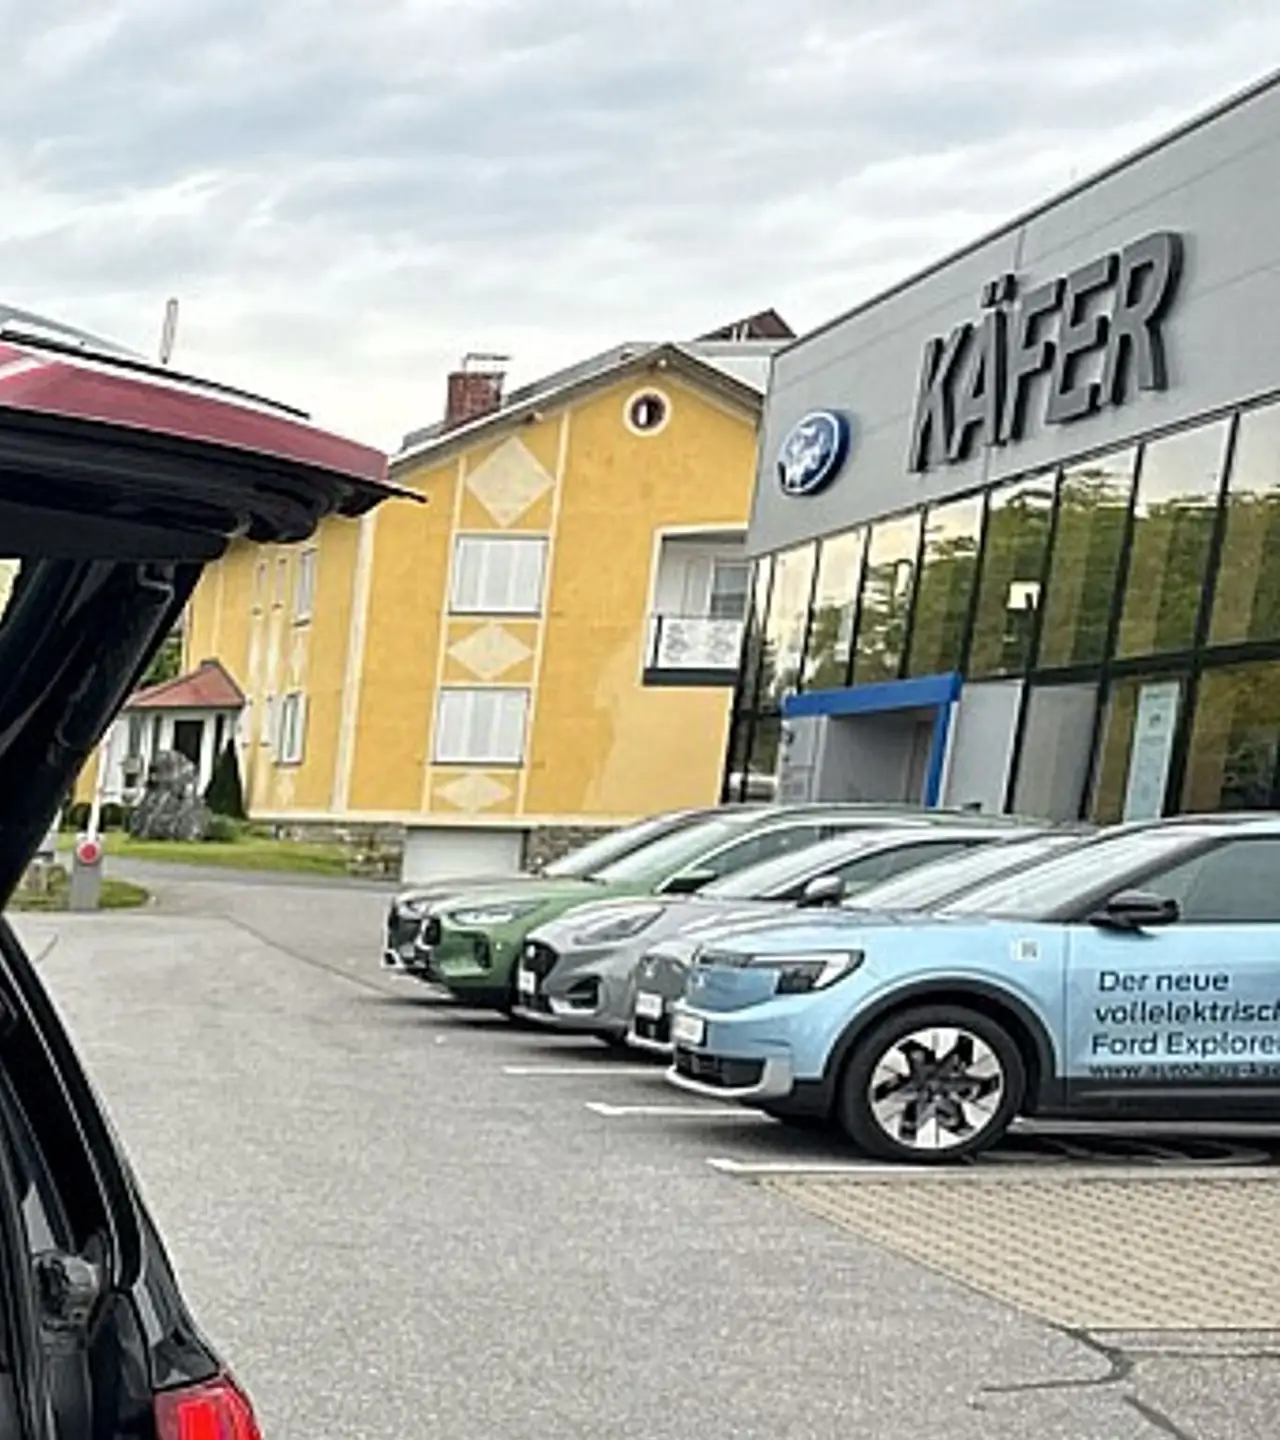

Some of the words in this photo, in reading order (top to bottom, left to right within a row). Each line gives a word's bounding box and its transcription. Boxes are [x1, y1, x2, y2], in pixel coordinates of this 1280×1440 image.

[908, 232, 1183, 472] KÄFER
[1099, 970, 1149, 992] Der
[1155, 971, 1228, 992] neue
[1092, 1031, 1157, 1055] Ford
[1167, 1030, 1280, 1059] Explore
